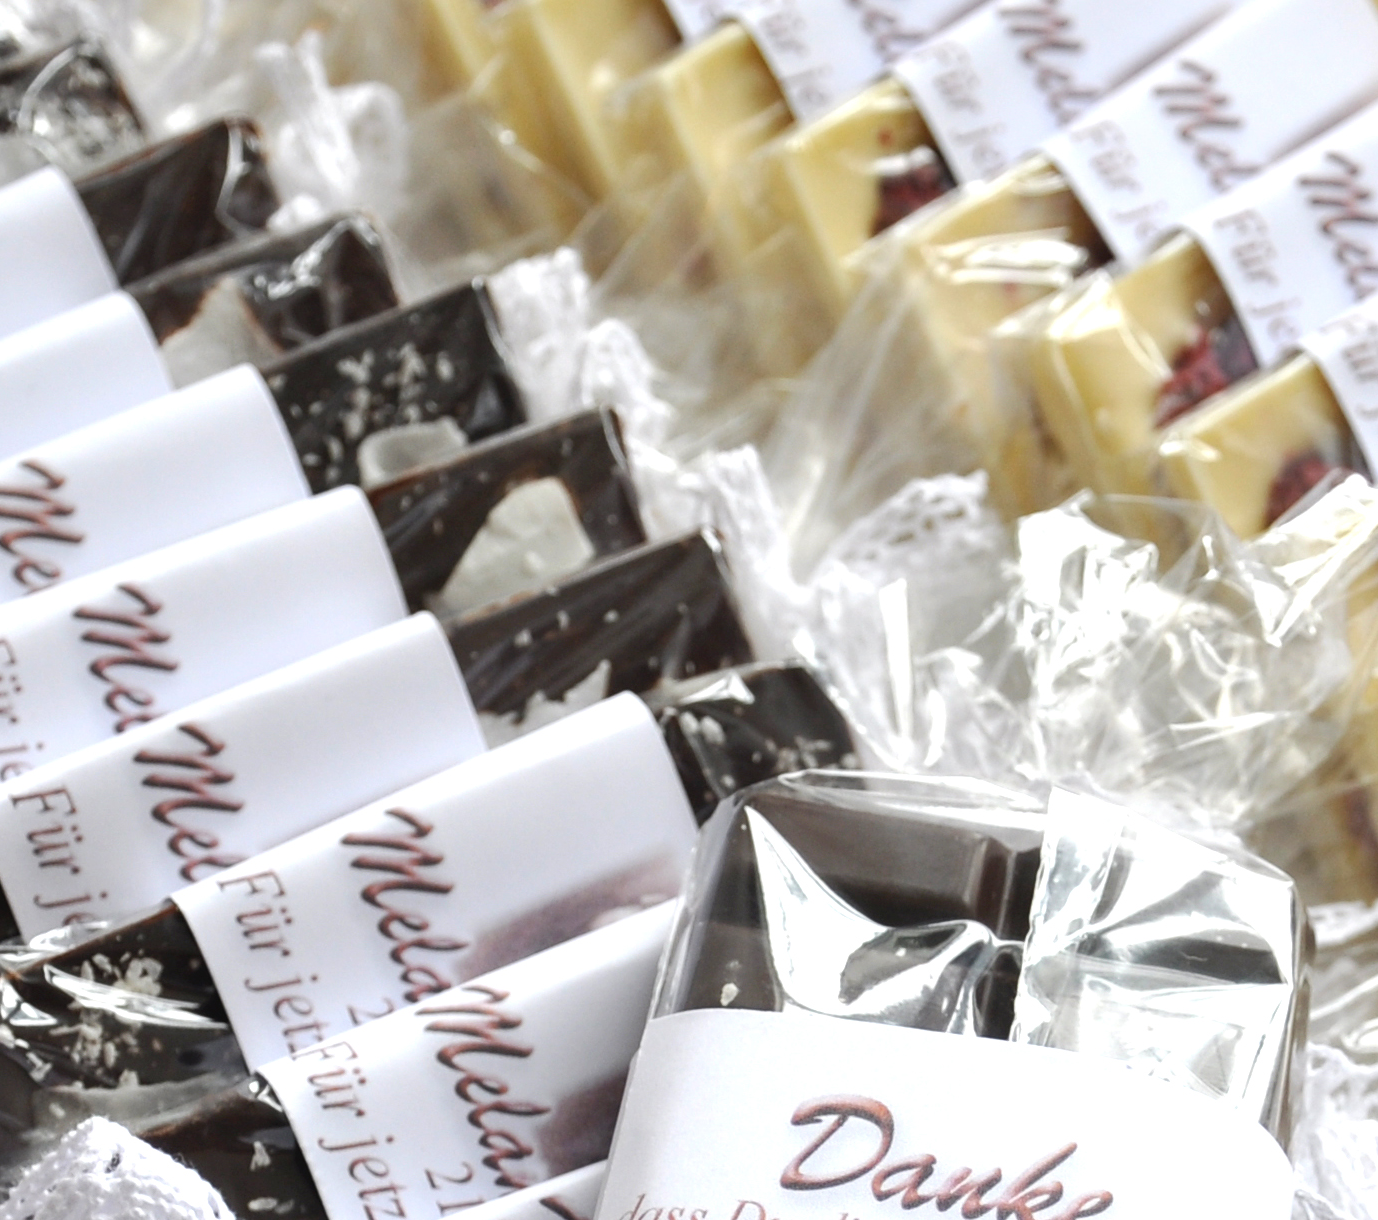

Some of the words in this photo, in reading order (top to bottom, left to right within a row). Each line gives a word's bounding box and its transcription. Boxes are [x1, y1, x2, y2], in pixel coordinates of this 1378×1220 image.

[8, 788, 84, 875] Für
[216, 869, 291, 959] Für
[291, 1040, 367, 1118] Für
